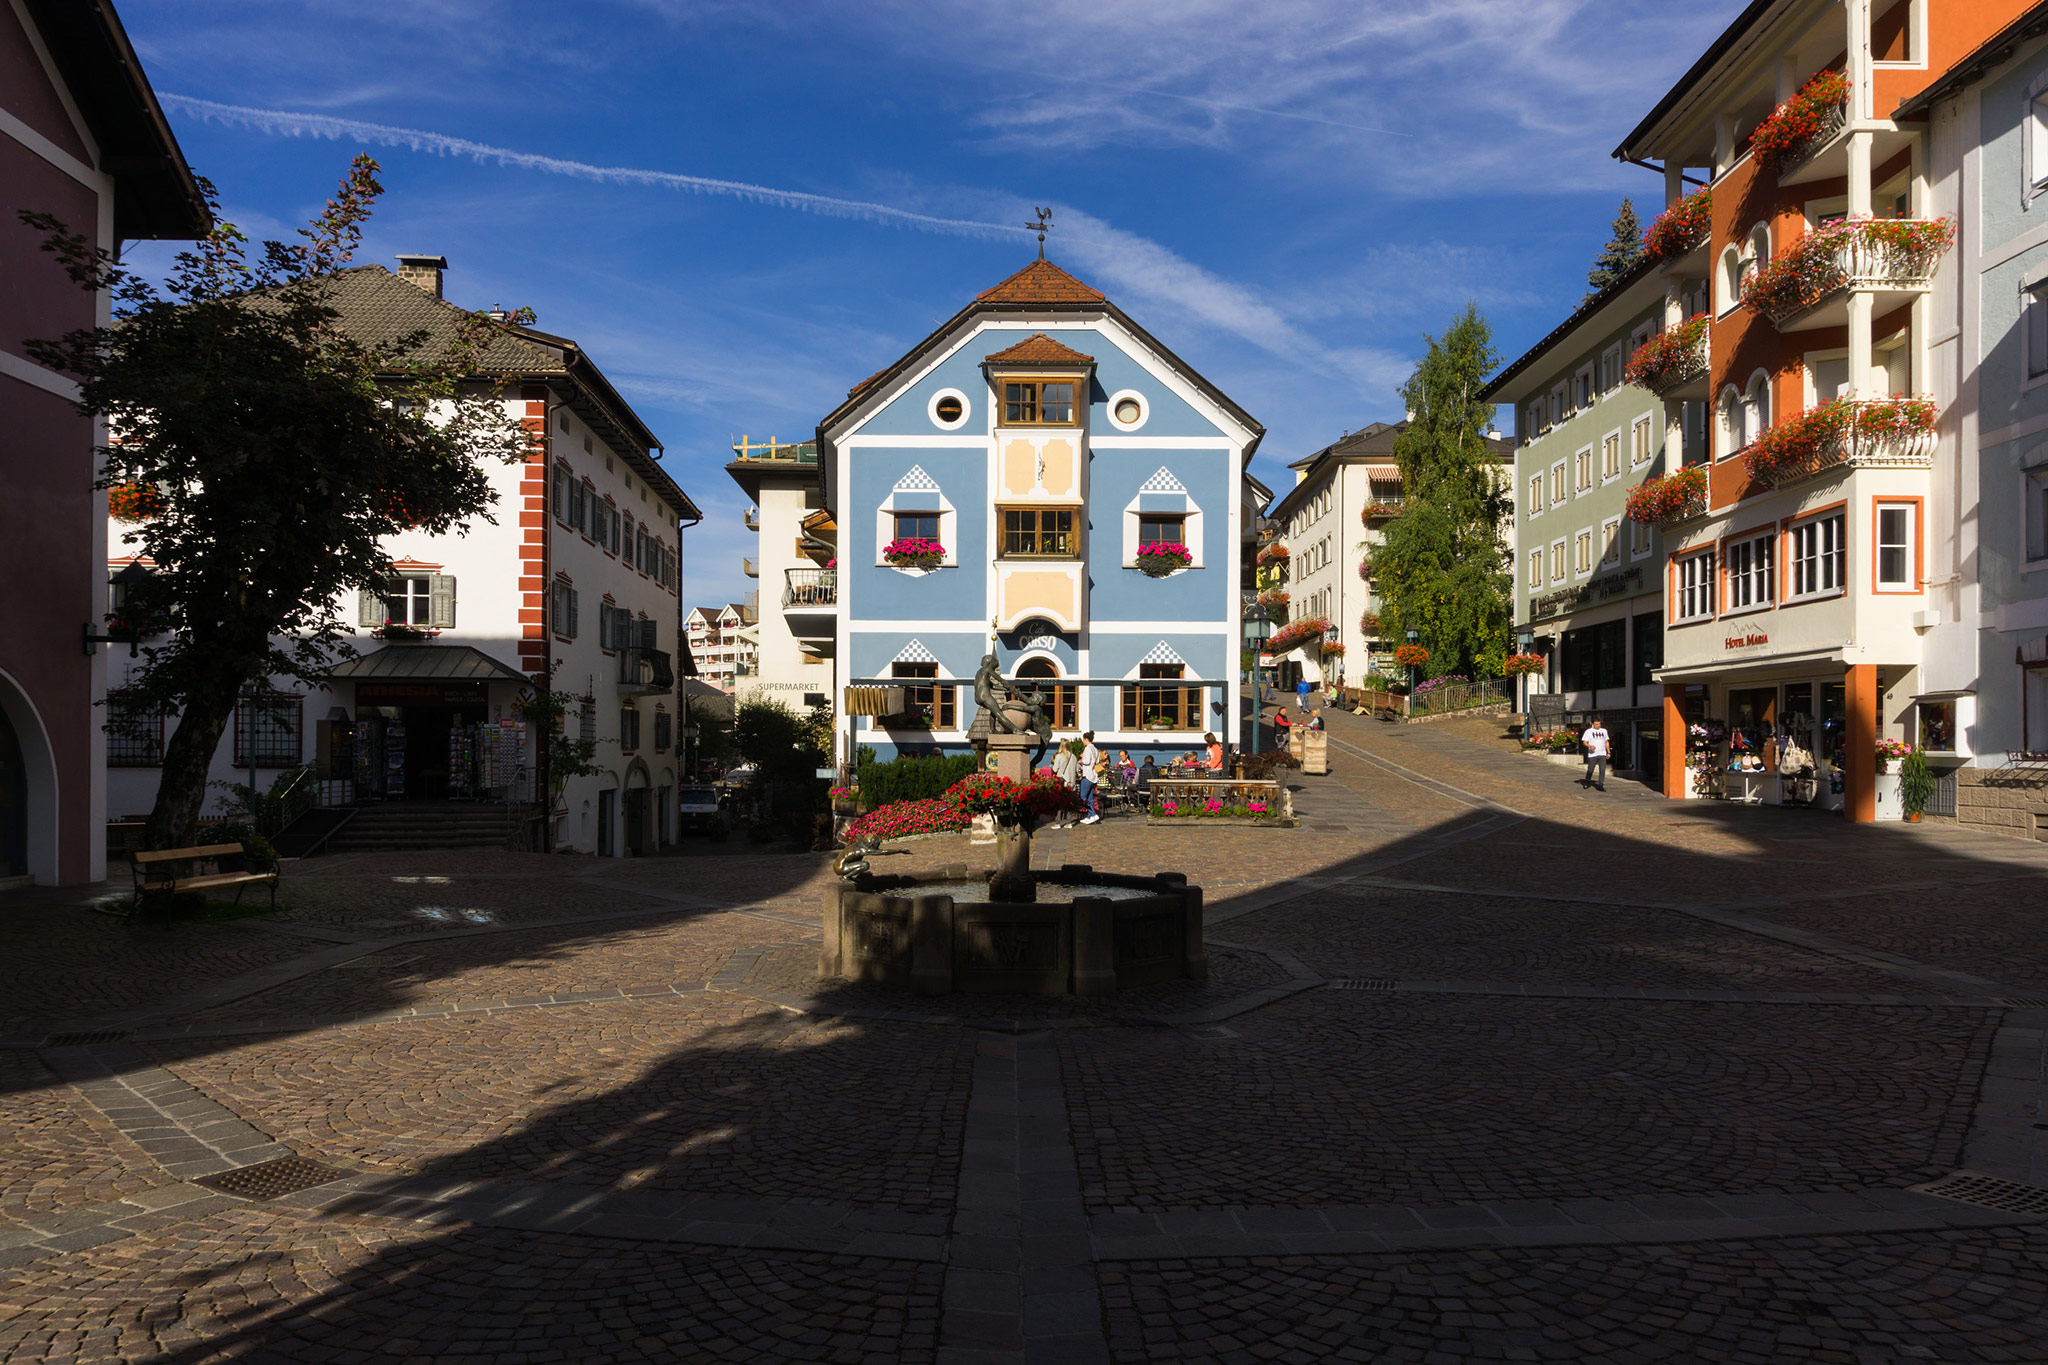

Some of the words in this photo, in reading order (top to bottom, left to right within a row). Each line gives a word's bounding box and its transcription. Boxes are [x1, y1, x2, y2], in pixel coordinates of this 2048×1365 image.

[1019, 634, 1057, 651] CORSO
[1725, 637, 1745, 650] HOTEL
[1746, 634, 1768, 646] MARIA
[758, 682, 819, 691] SUPERMARKET
